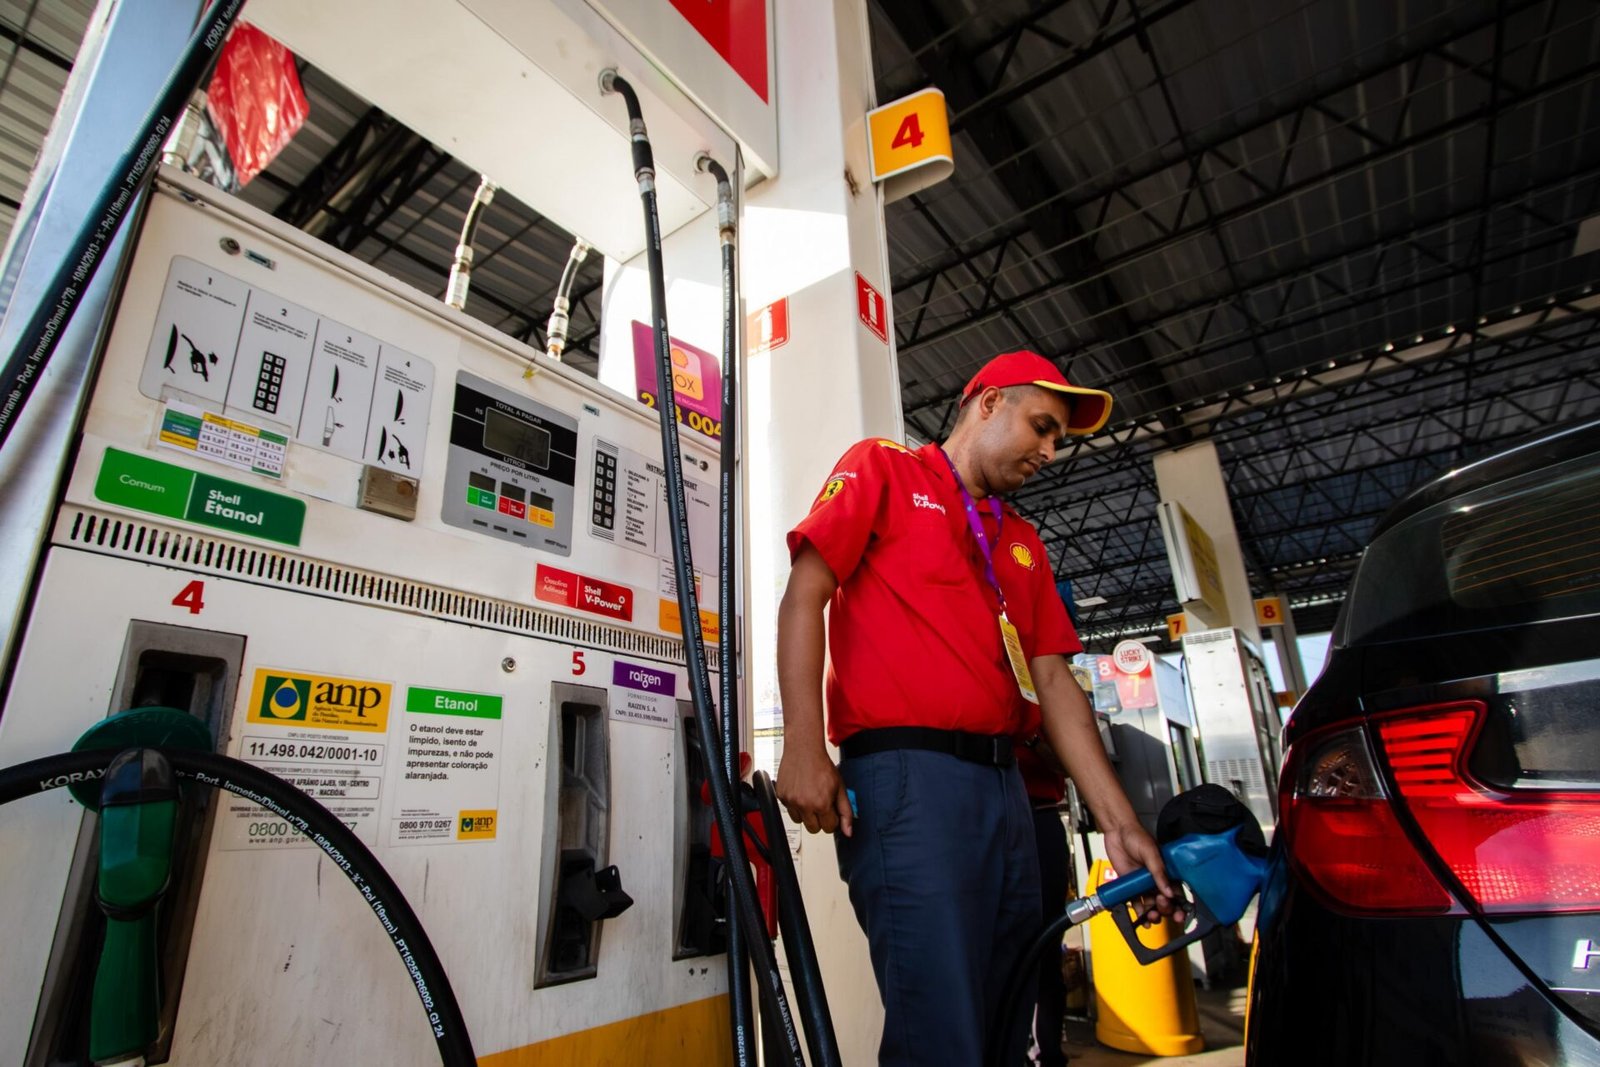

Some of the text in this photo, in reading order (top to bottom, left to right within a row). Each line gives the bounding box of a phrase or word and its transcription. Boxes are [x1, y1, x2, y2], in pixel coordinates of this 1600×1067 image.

[204, 17, 228, 51] KORAX
[890, 112, 925, 150] 4
[33, 303, 67, 364] Inmetro/Dimel
[72, 243, 100, 282] 19/04/2013
[106, 186, 132, 217] (19mm)
[160, 114, 172, 128] 24
[674, 374, 695, 393] OX
[495, 400, 514, 414] TOTAL
[521, 411, 542, 425] PAGAR
[503, 456, 526, 469] LITROS
[490, 461, 540, 483] PREÇO POR LITRO
[118, 474, 166, 494] Comum
[208, 489, 242, 506] Shell
[912, 492, 929, 502] Shell
[204, 500, 264, 526] Etanol
[544, 576, 568, 588] Gasolina
[171, 580, 206, 616] 4
[584, 586, 602, 596] Shell
[584, 594, 622, 611] V-Power
[1262, 605, 1277, 620] 8
[1172, 620, 1182, 634] 7
[1120, 648, 1141, 658] LUCKY
[1120, 655, 1142, 664] STRIKE
[572, 650, 586, 676] 5
[1098, 661, 1111, 676] 8
[314, 681, 382, 718] anp
[434, 695, 478, 712] Etanol
[410, 724, 484, 736] O etanol deve estar
[442, 737, 467, 746] isento
[468, 738, 478, 747] de
[249, 742, 378, 762] 11.498.042/0001-10
[408, 747, 452, 758] impurezas,
[459, 750, 474, 758] não
[475, 750, 494, 760] pode
[406, 760, 488, 771] apresentar coloração
[404, 770, 450, 782] alaranjada.
[248, 822, 288, 836] 0800
[399, 820, 452, 830] 0800 970 0267
[474, 816, 494, 828] anp
[39, 767, 108, 791] KORAX
[224, 780, 290, 818] Inmetro/Dimel
[312, 832, 352, 871] 19/04/2013
[372, 900, 399, 936] (19mm)
[433, 1026, 446, 1039] 24
[776, 994, 799, 1053] TRANSPOWER
